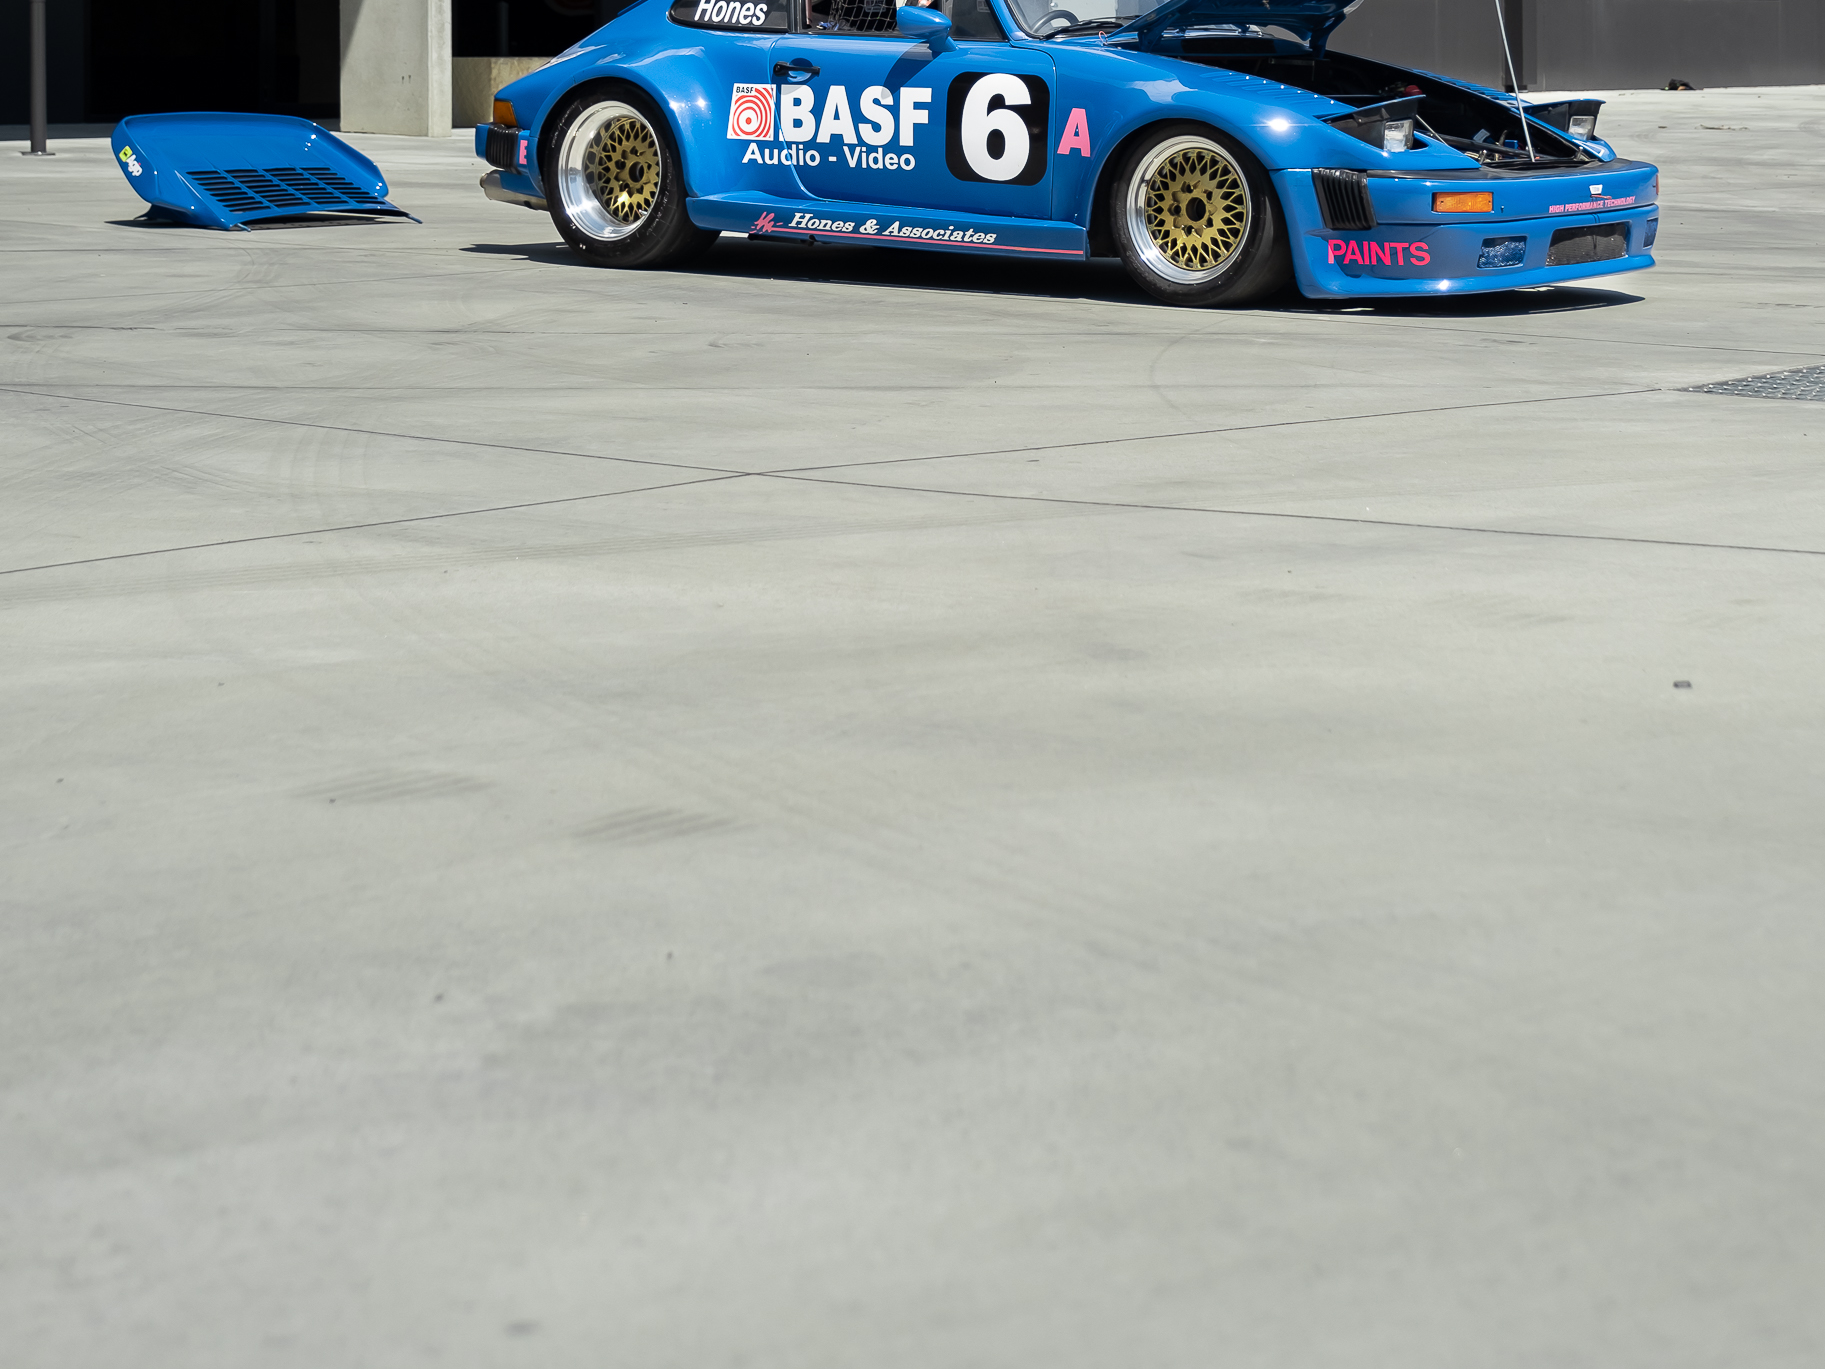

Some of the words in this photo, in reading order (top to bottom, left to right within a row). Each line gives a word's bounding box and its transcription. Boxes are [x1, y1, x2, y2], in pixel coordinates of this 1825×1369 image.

[736, 86, 754, 94] BASF
[779, 84, 932, 146] BASF
[961, 72, 1031, 181] 6
[1056, 107, 1091, 157] A
[742, 142, 821, 167] Audio
[843, 145, 916, 171] Video
[1549, 204, 1564, 213] HIGH
[1565, 200, 1604, 212] PERFORMANCE
[1604, 195, 1636, 208] TECHNOLOGY
[788, 212, 856, 232] Hones
[859, 218, 880, 234] &
[882, 220, 997, 244] Associates
[1328, 239, 1431, 266] PAINTS
